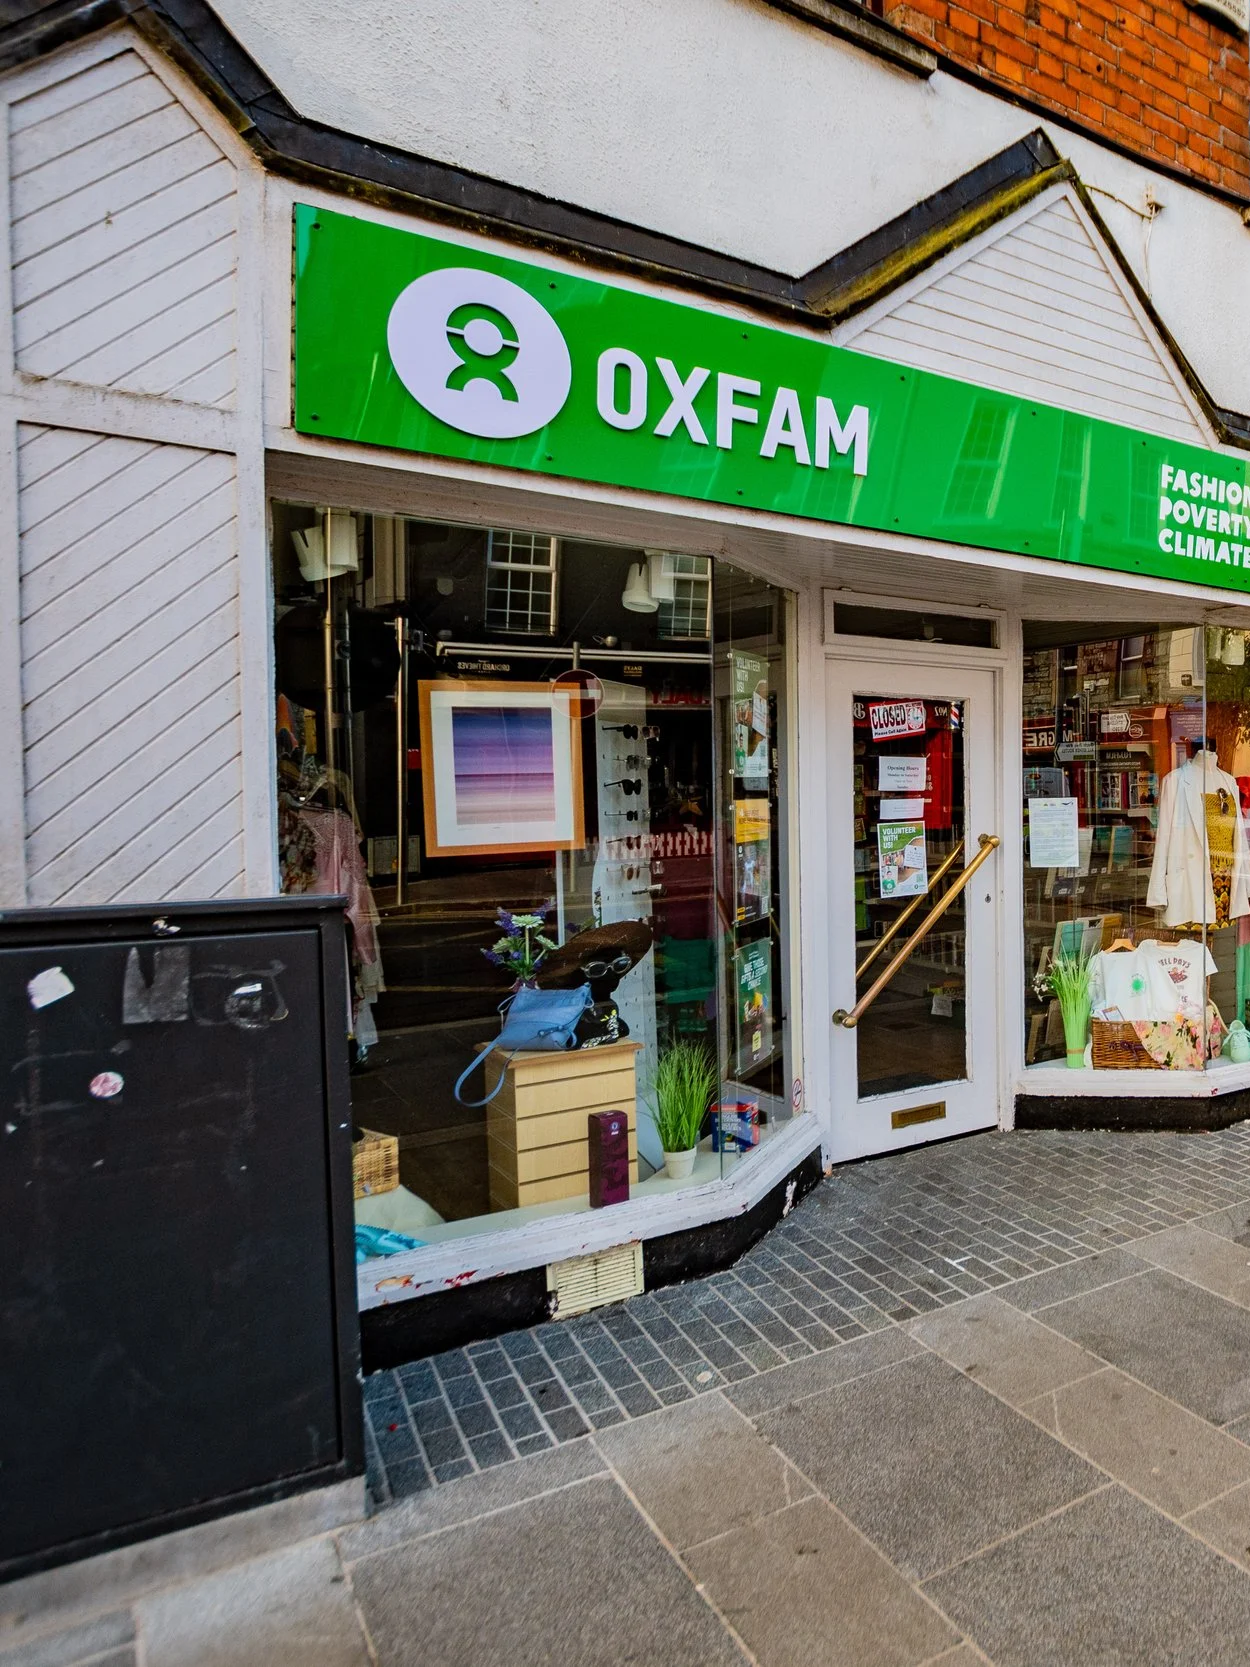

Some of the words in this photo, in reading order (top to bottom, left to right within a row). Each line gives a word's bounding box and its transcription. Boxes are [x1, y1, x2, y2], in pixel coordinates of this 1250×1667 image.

[596, 346, 871, 477] OXFAM
[871, 704, 906, 730] CLOSED
[882, 827, 916, 835] VOLUNTEER
